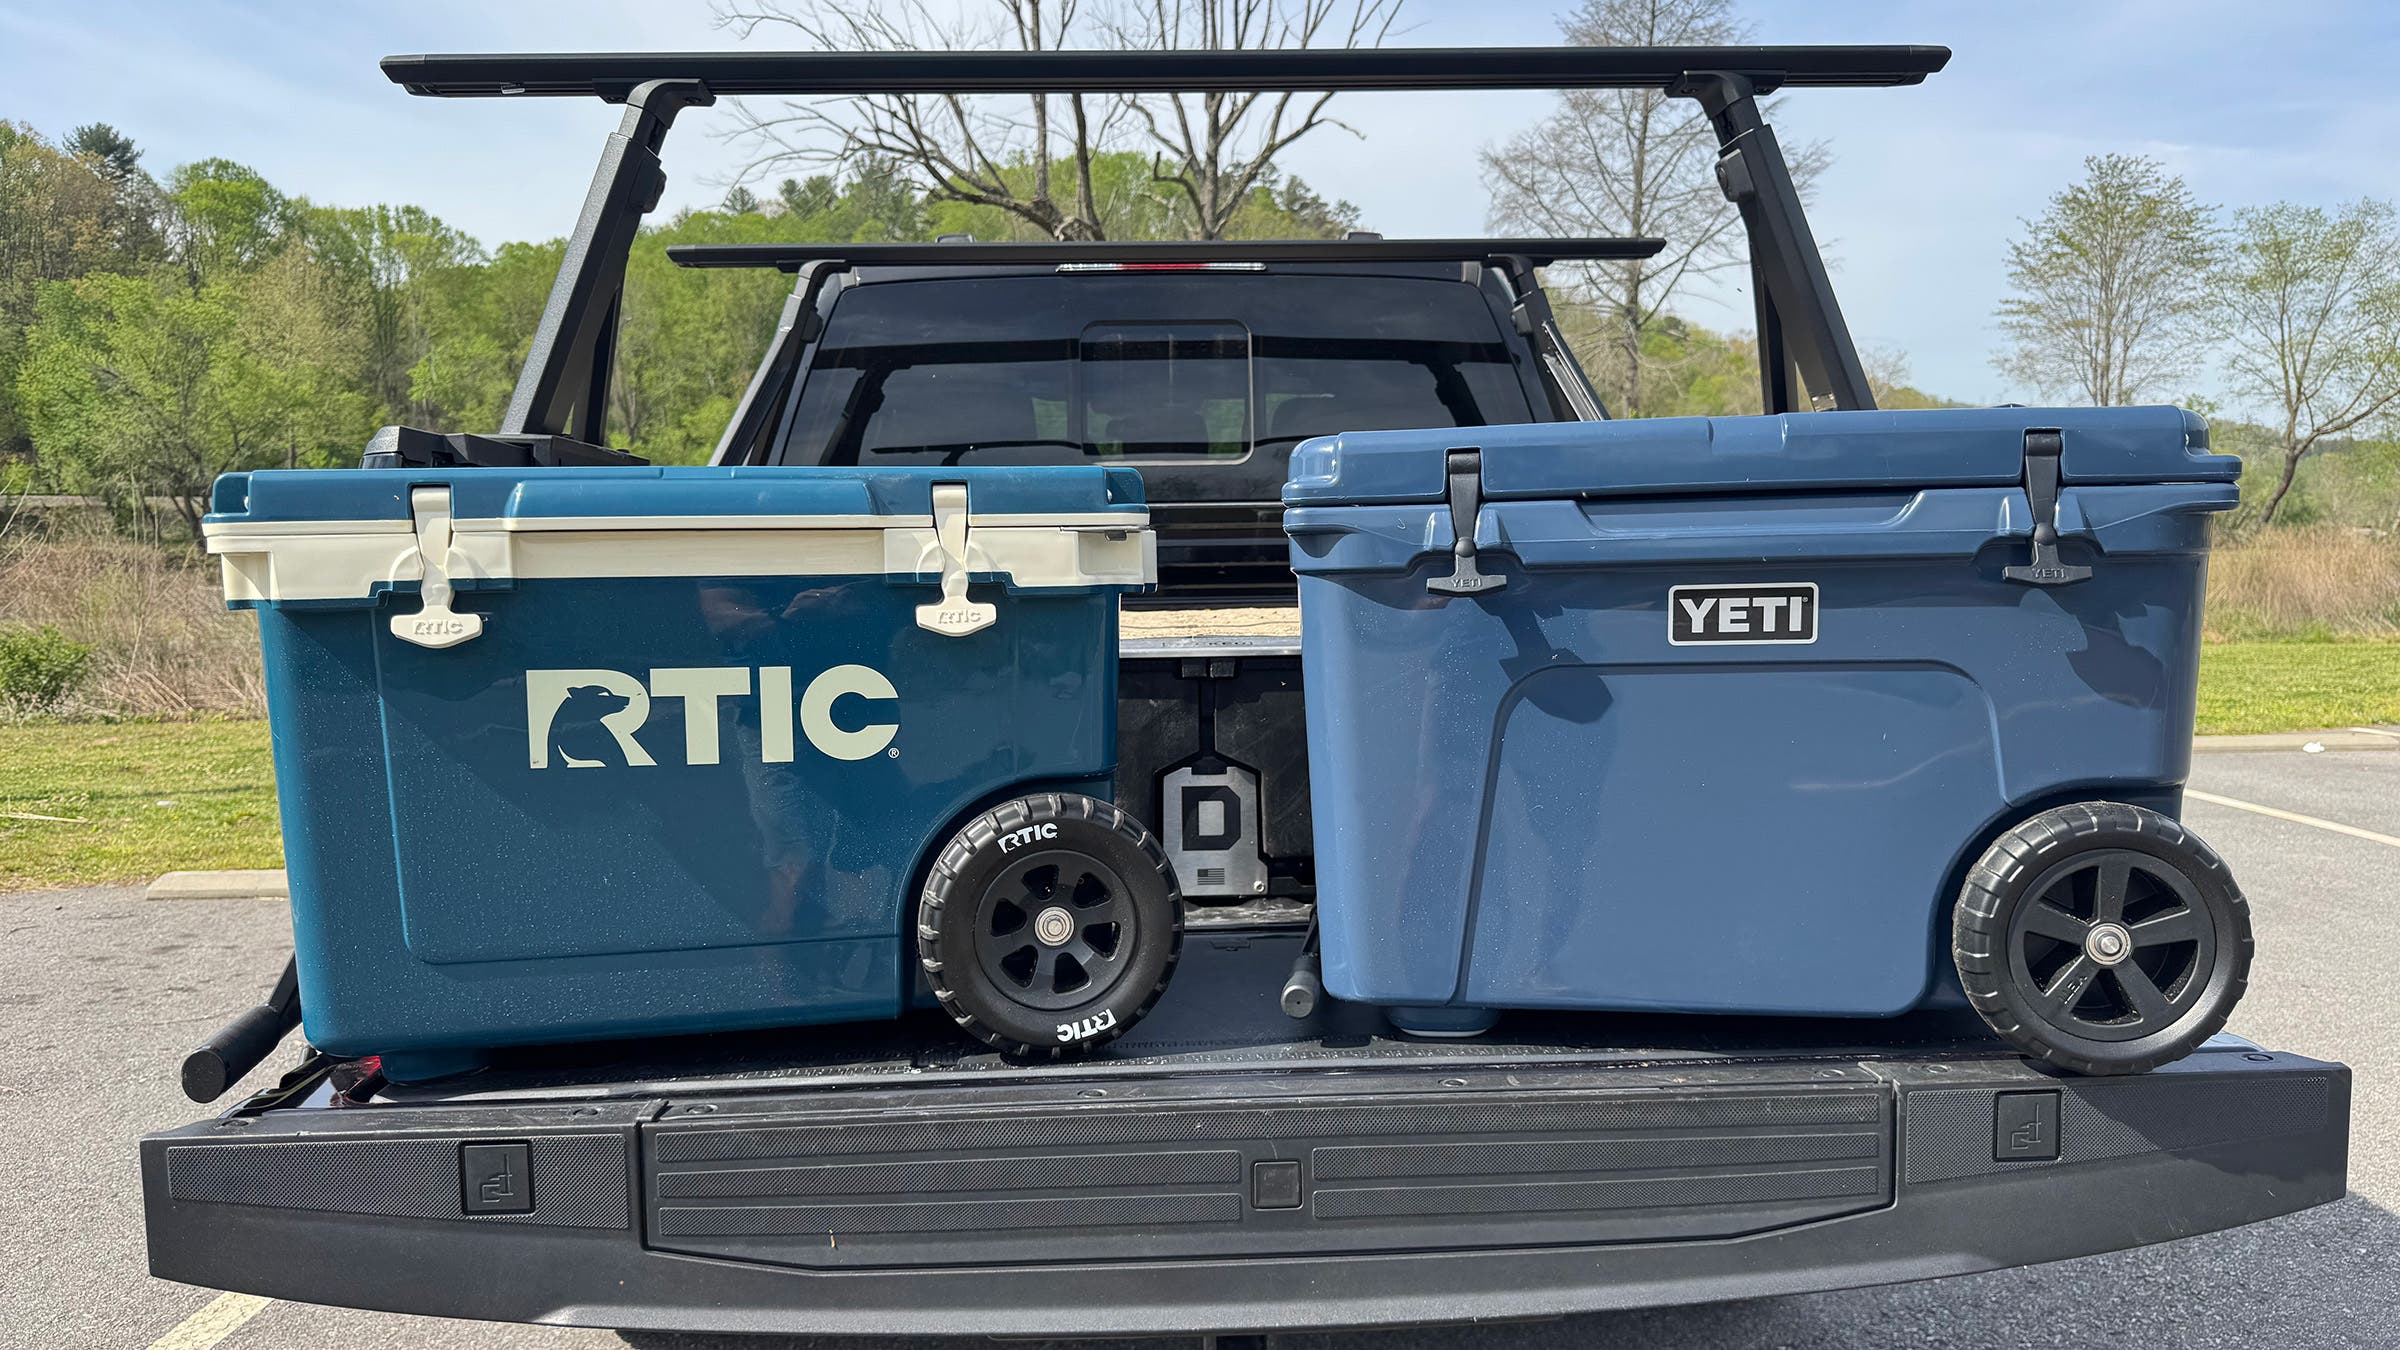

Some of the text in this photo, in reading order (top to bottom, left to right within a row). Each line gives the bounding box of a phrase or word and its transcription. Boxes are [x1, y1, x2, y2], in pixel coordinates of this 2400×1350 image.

[1451, 577, 1482, 588] YETI
[2031, 567, 2065, 578] YETI
[412, 618, 464, 636] RTIC
[937, 608, 982, 624] RTIC
[1679, 596, 1803, 634] YETI
[526, 664, 900, 769] RTIC
[1182, 785, 1242, 851] D
[998, 822, 1058, 854] RTIC
[1056, 1008, 1118, 1042] RTIC
